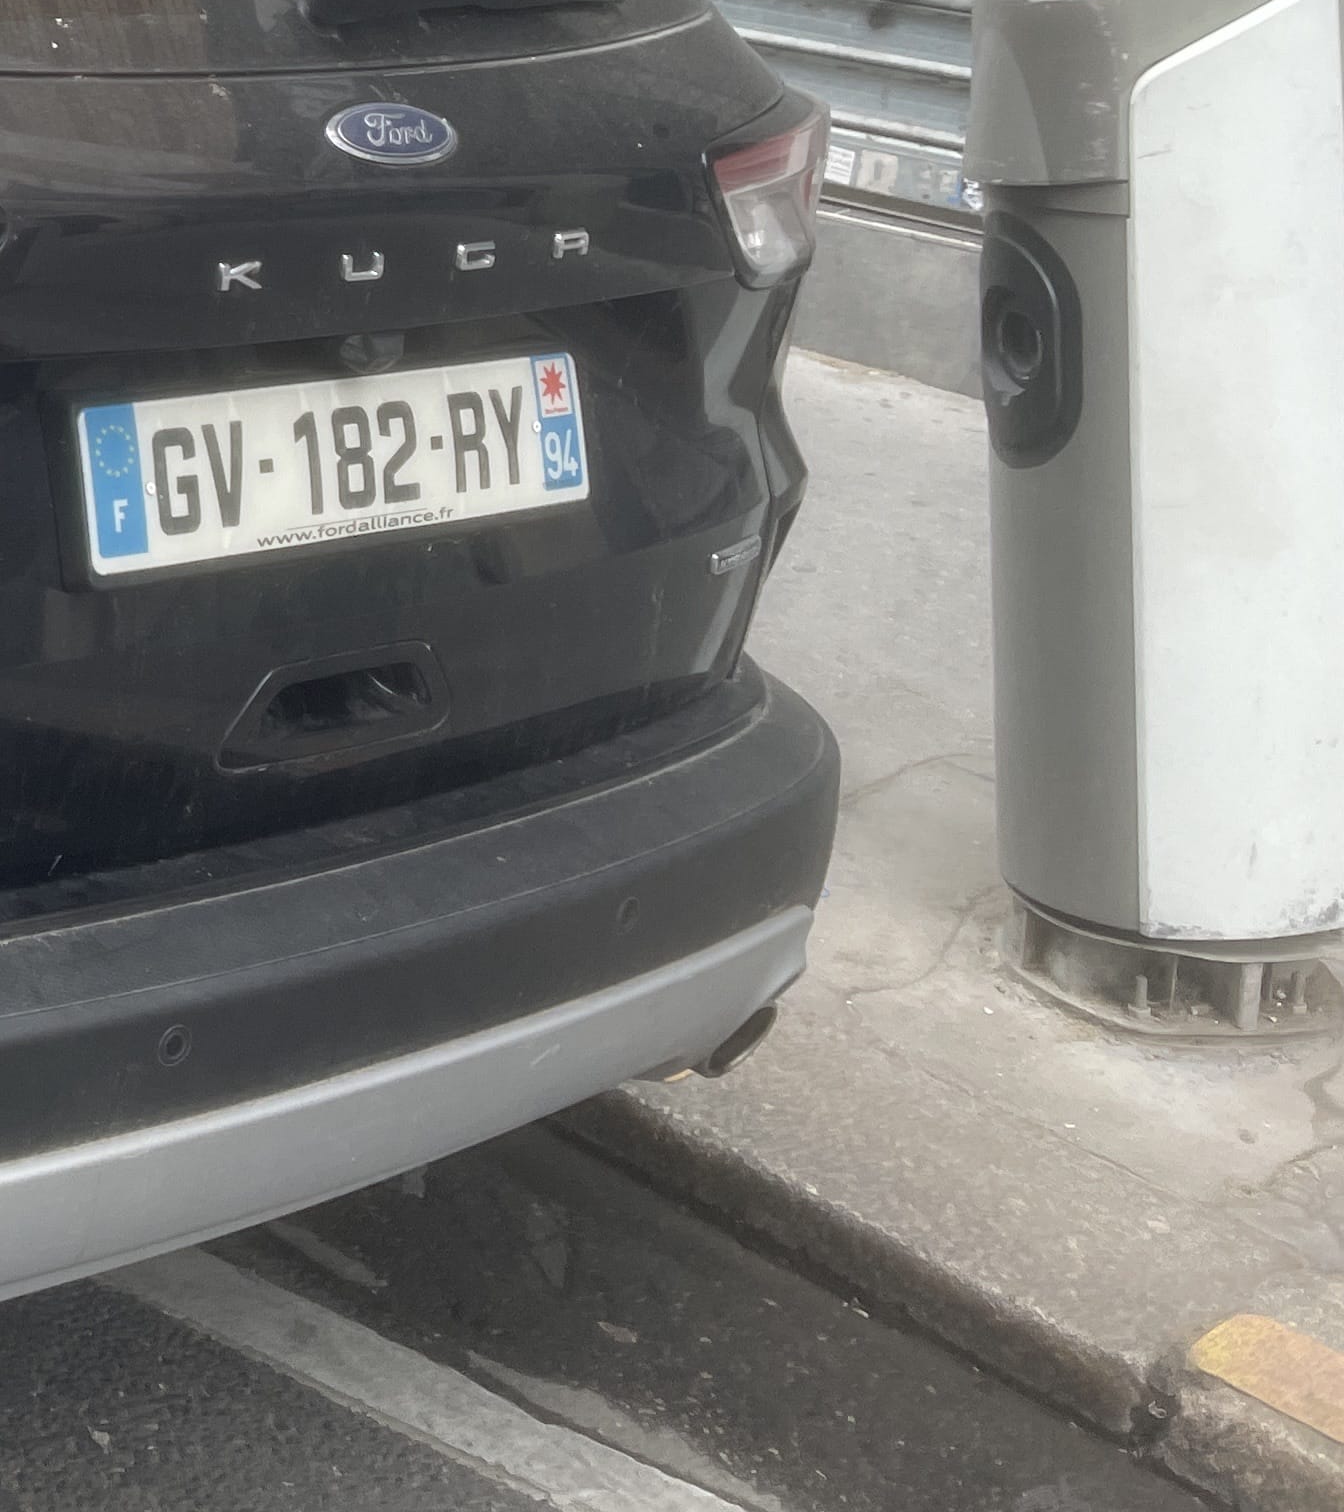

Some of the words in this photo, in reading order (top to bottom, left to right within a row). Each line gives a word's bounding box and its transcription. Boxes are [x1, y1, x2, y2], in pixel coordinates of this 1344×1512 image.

[364, 112, 433, 147] Ford
[219, 228, 589, 291] KUGA
[151, 385, 523, 536] GV-182-RY
[544, 429, 578, 480] 94
[113, 498, 129, 533] F
[256, 505, 454, 548] www.fordalliance.fr
